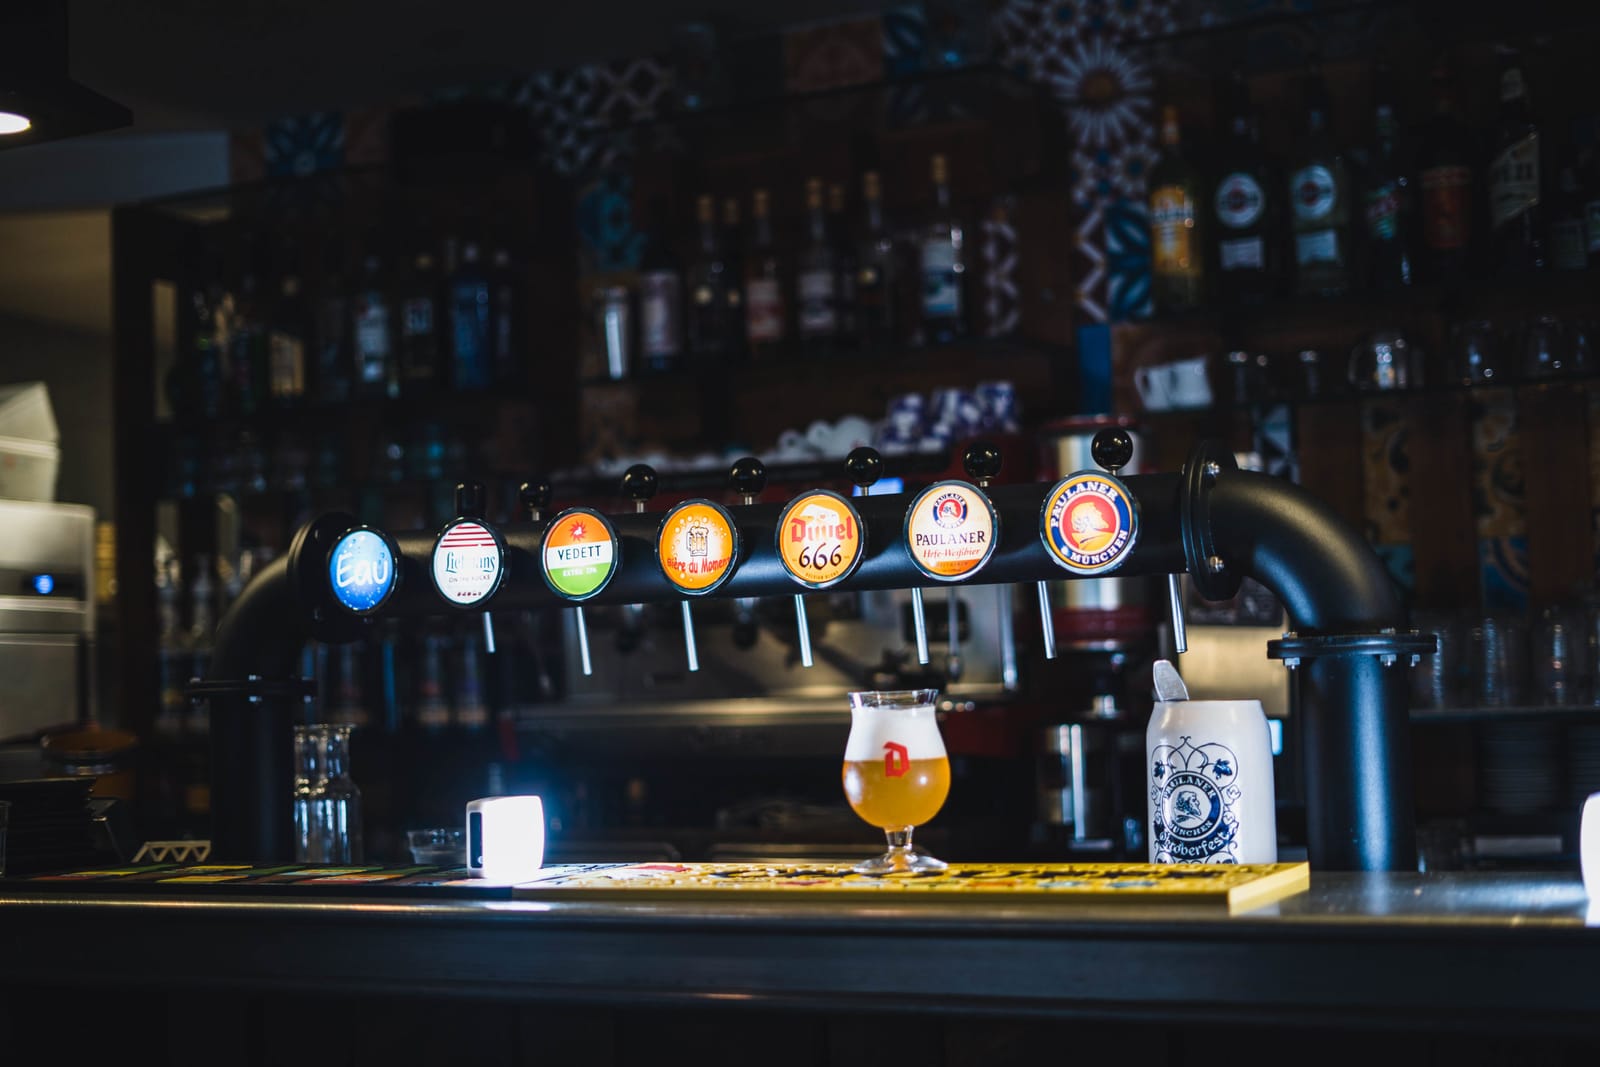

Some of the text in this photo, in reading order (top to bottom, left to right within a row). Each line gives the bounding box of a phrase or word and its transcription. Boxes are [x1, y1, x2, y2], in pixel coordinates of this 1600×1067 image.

[1051, 481, 1119, 527] PAULANER
[790, 514, 853, 543] Duvel
[915, 530, 986, 546] PAULANER
[557, 545, 602, 561] VEDETT
[666, 557, 687, 573] Bière
[688, 558, 698, 574] du
[883, 741, 911, 778] D
[1162, 776, 1217, 800] PAULANER
